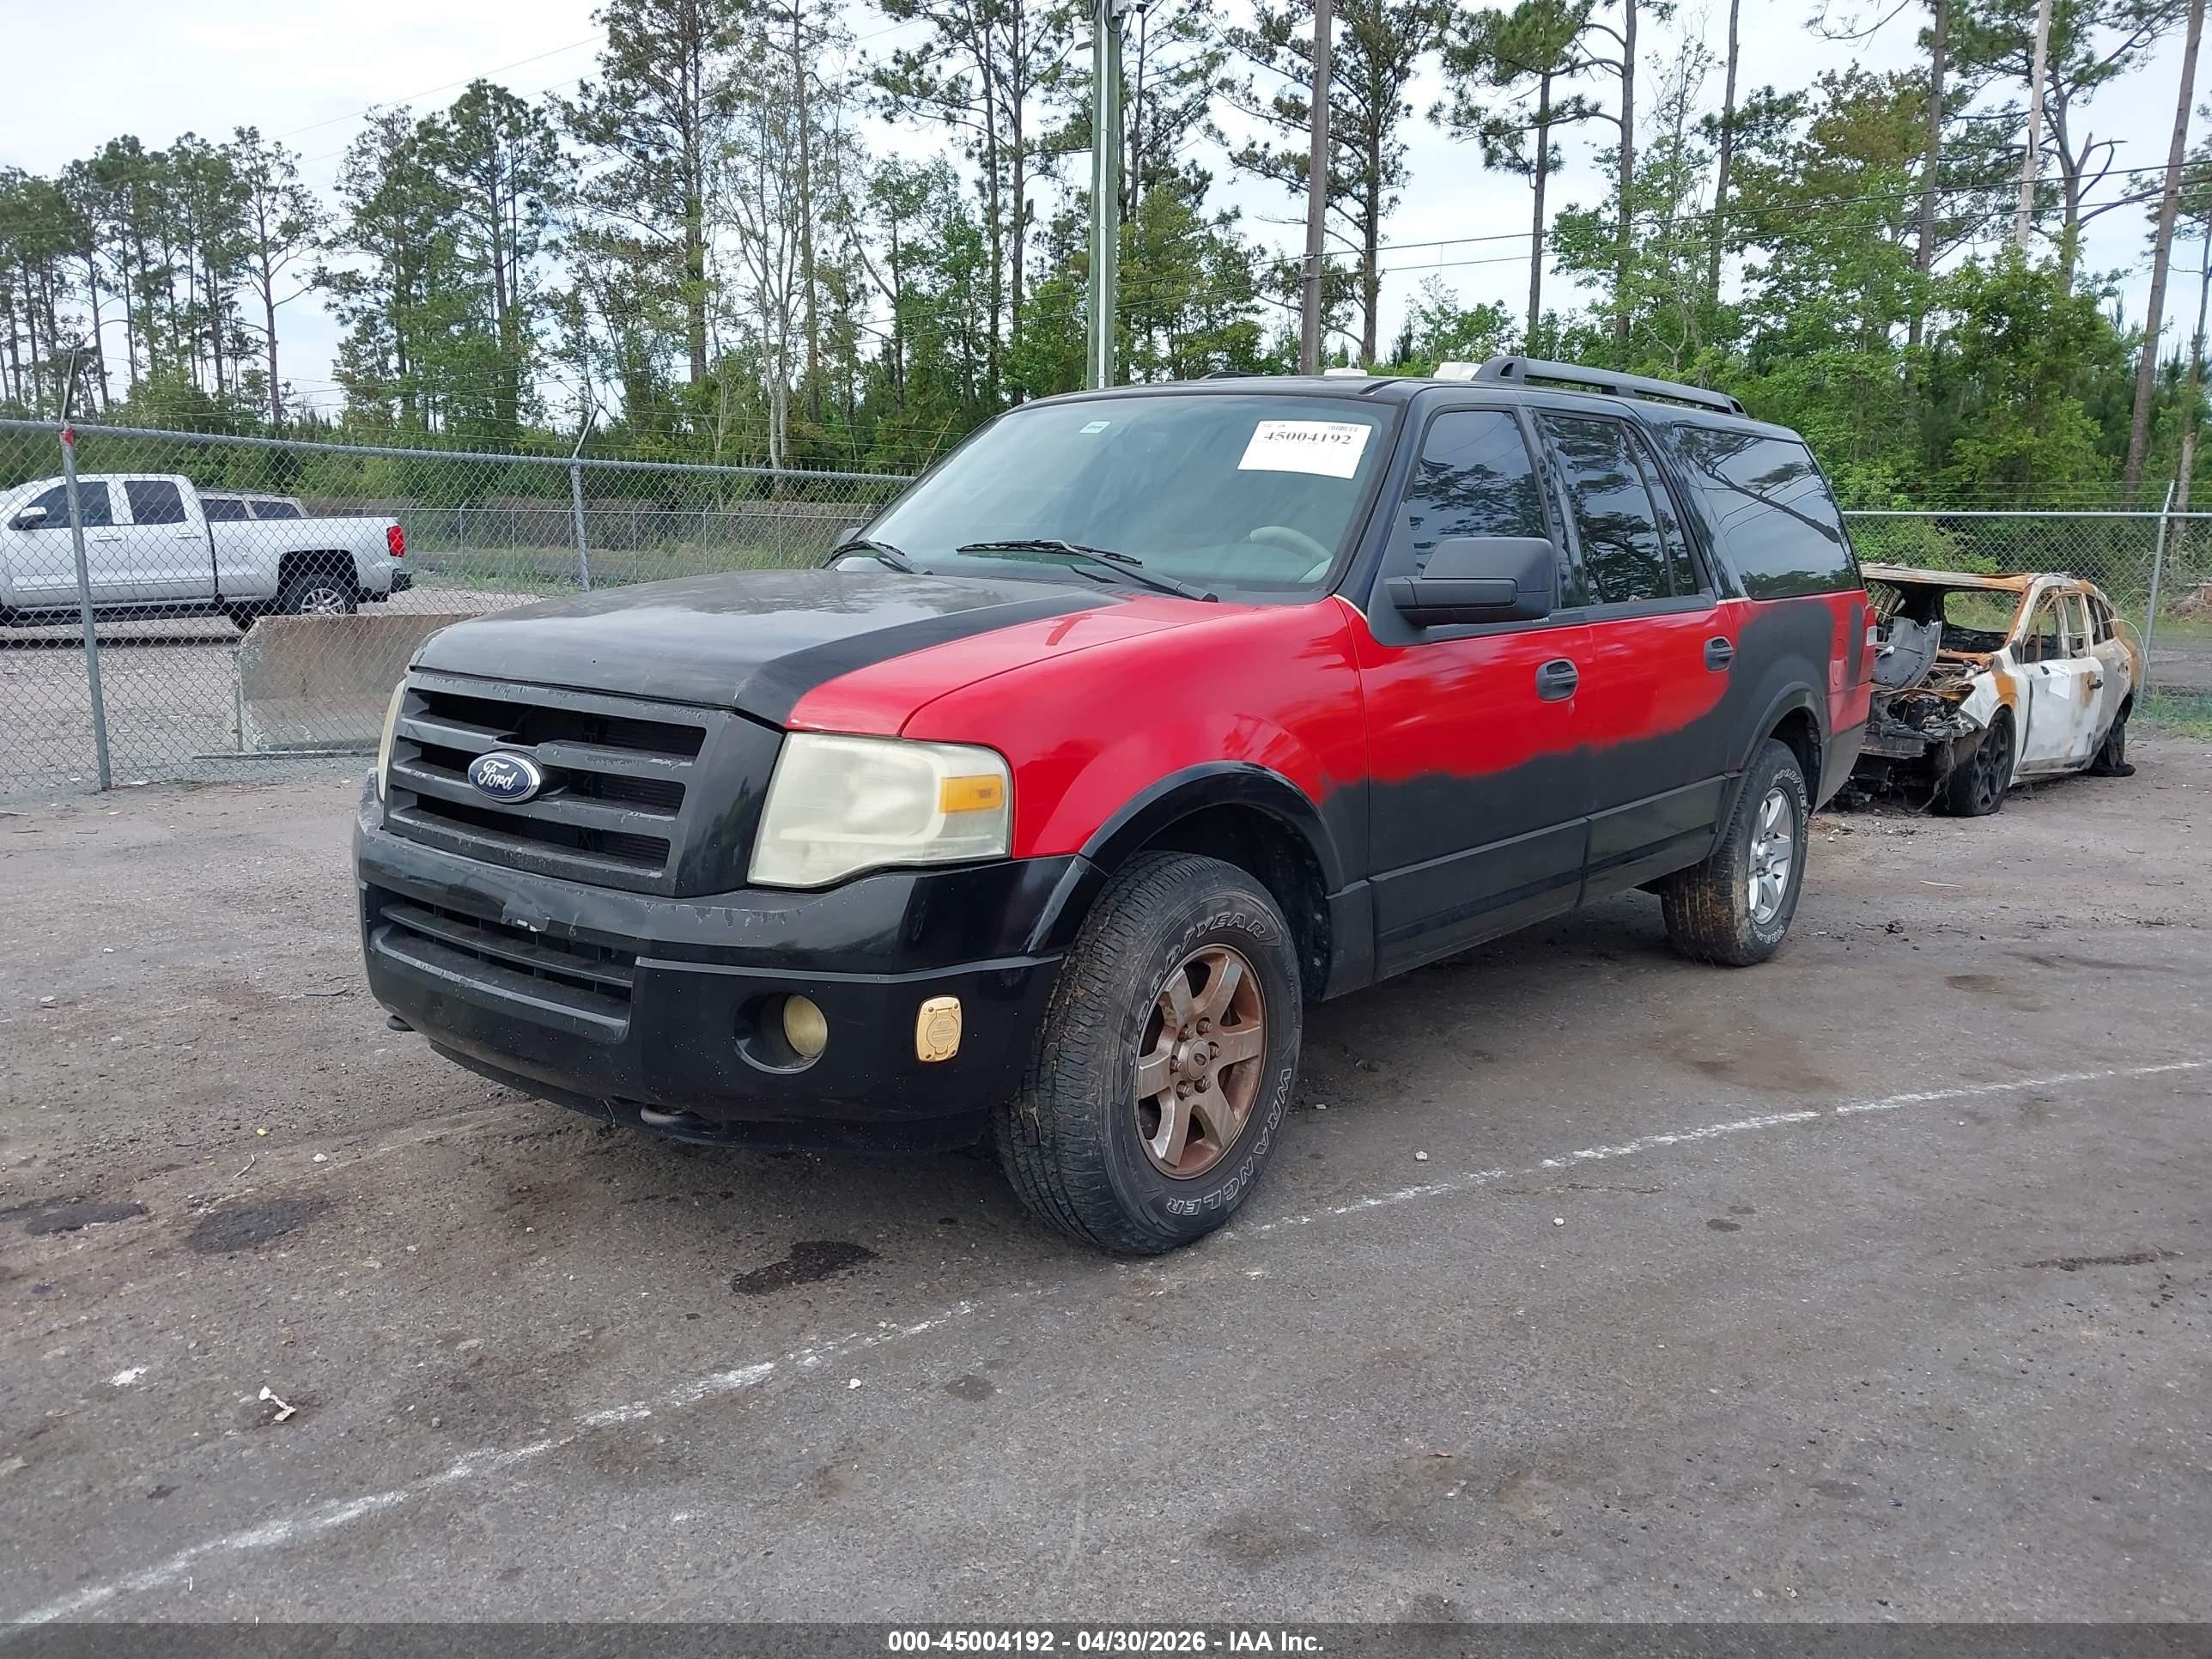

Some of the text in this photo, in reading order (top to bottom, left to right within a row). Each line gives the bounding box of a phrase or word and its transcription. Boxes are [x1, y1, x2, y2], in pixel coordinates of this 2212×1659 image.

[1263, 431, 1352, 445] 45004192
[477, 760, 518, 791] Ford
[1166, 1067, 1292, 1216] WRANGLER
